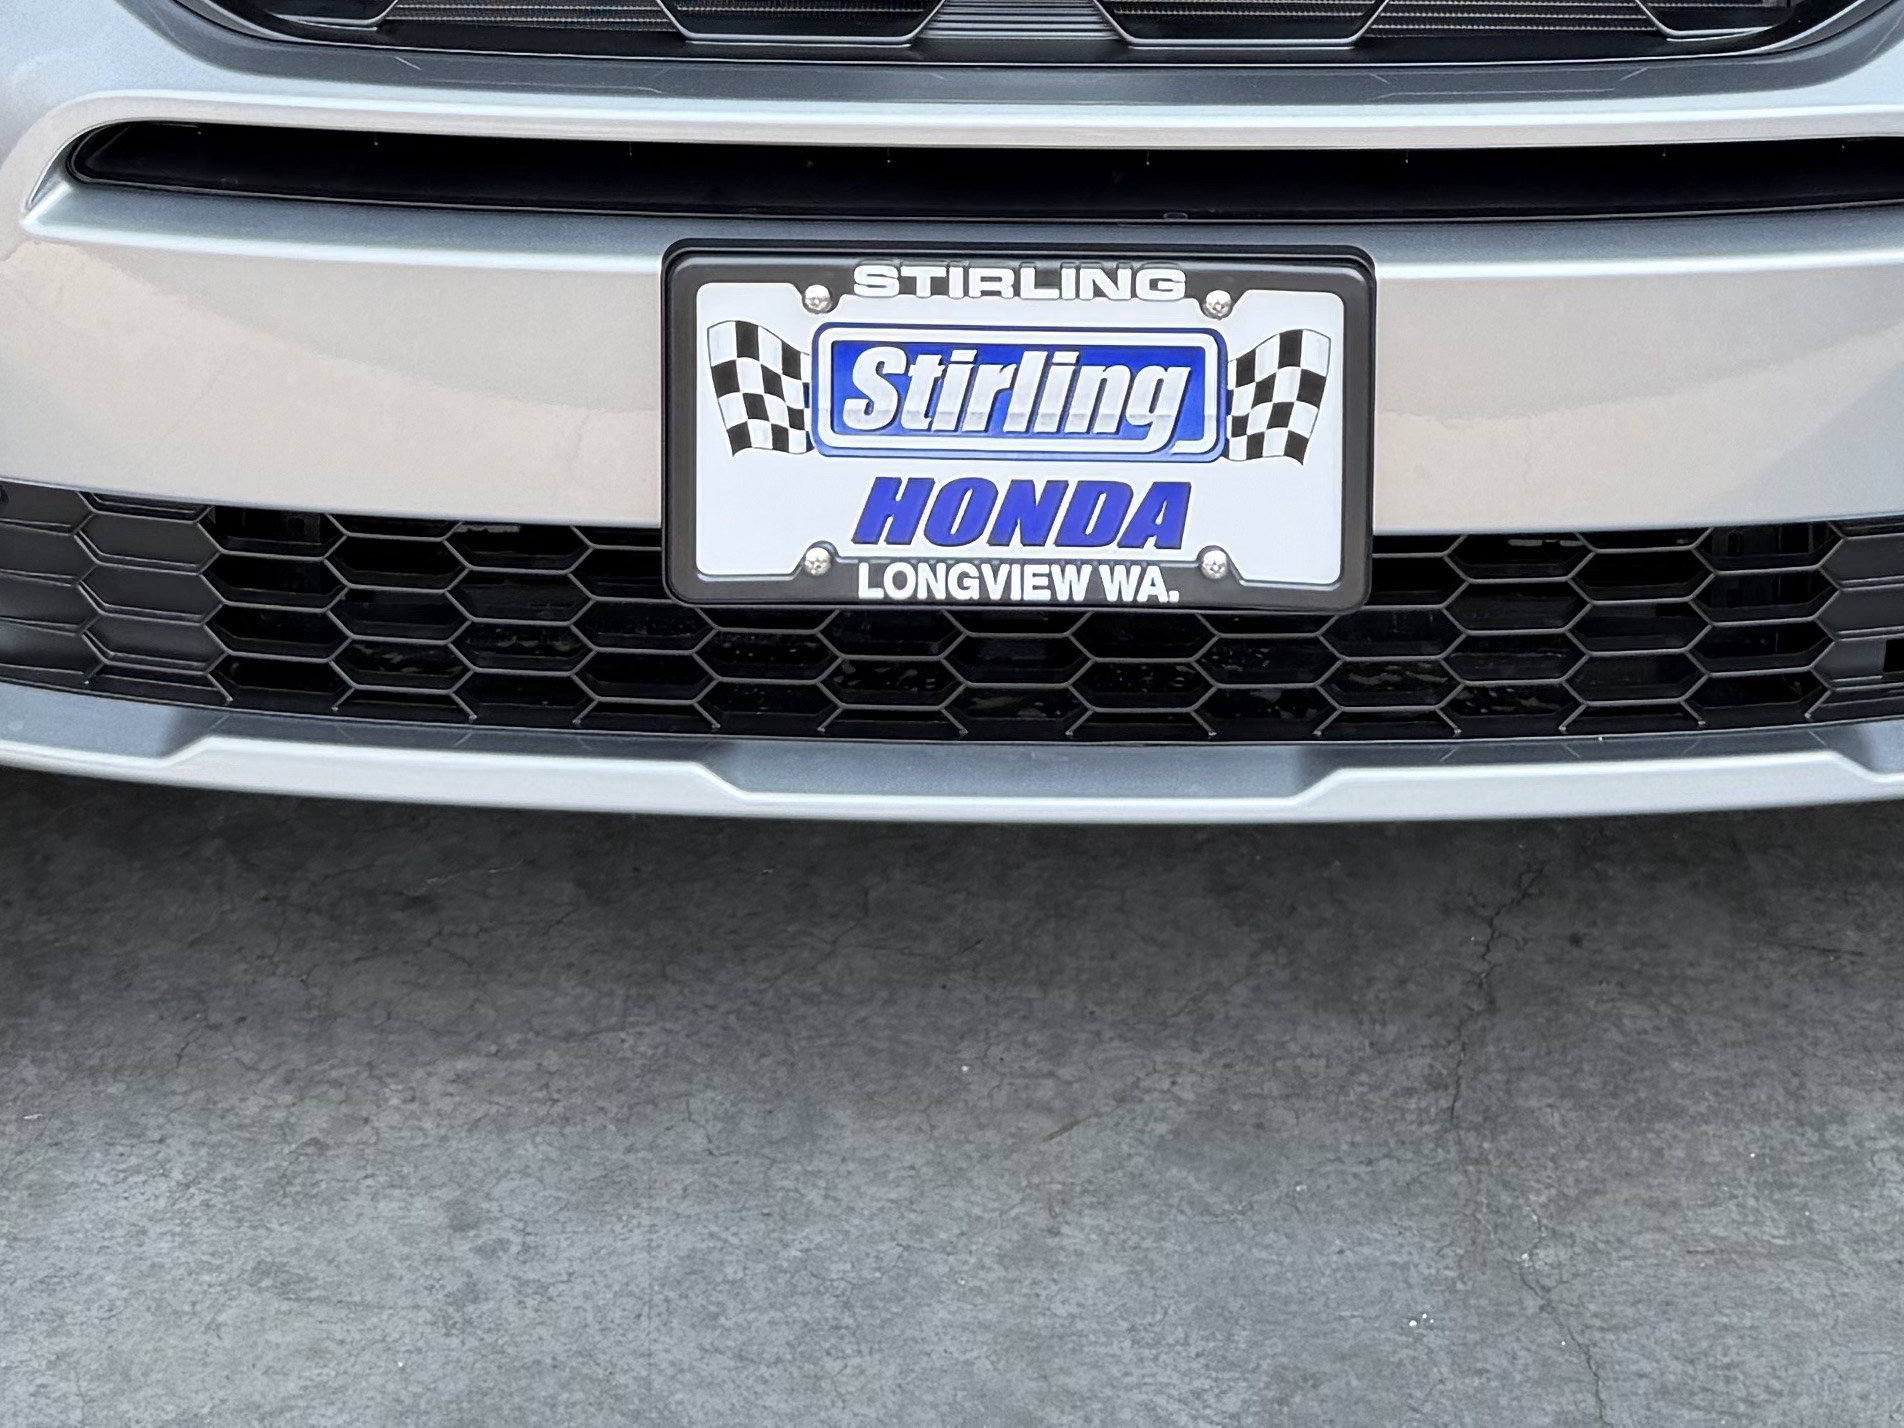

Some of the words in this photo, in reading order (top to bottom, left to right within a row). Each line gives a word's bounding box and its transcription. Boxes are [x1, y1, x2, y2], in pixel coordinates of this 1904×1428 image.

[853, 263, 1187, 300] STIRLING
[843, 347, 1192, 448] Stirling
[853, 477, 1192, 549] HONDA
[858, 563, 1093, 601] LONGVIEW
[1098, 564, 1180, 603] WA.
